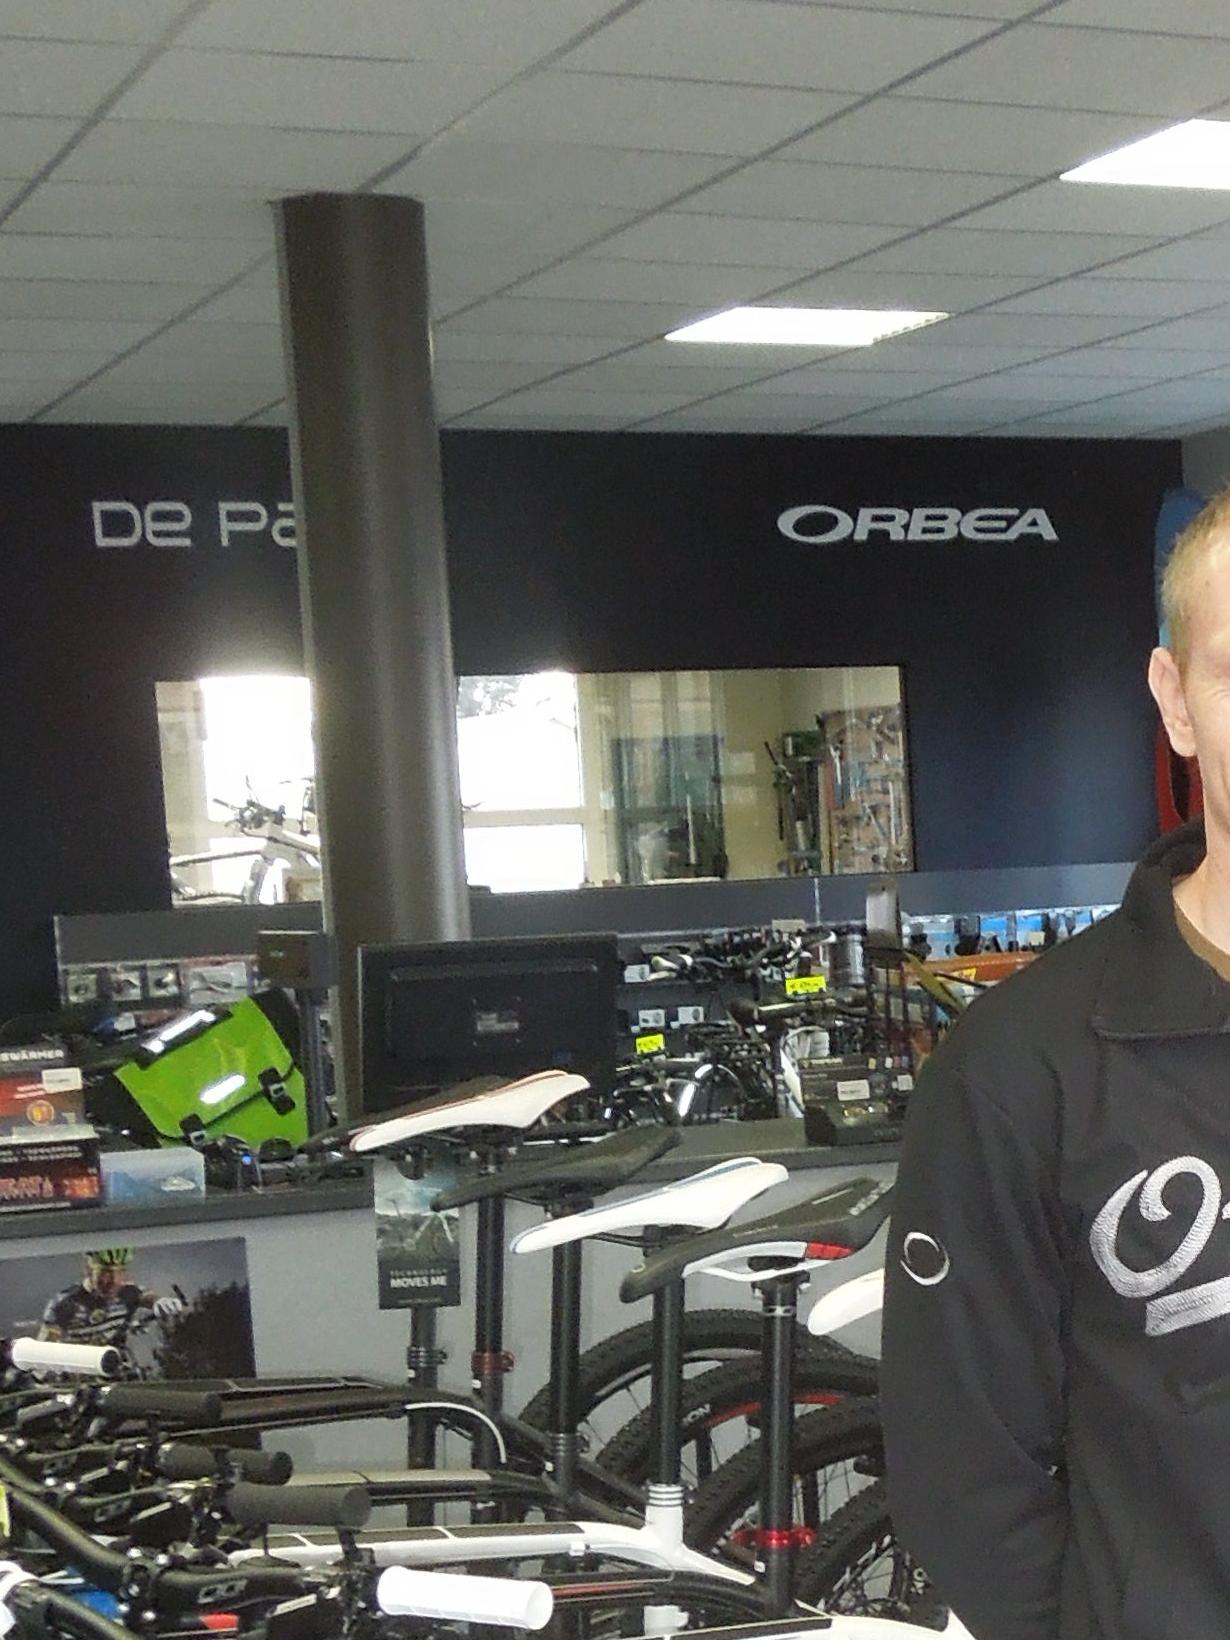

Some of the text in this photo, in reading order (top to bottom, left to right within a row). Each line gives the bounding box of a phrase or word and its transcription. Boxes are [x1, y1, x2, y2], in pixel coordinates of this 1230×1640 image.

[777, 504, 1059, 545] ORBEA
[390, 1275, 448, 1288] MOVES ME
